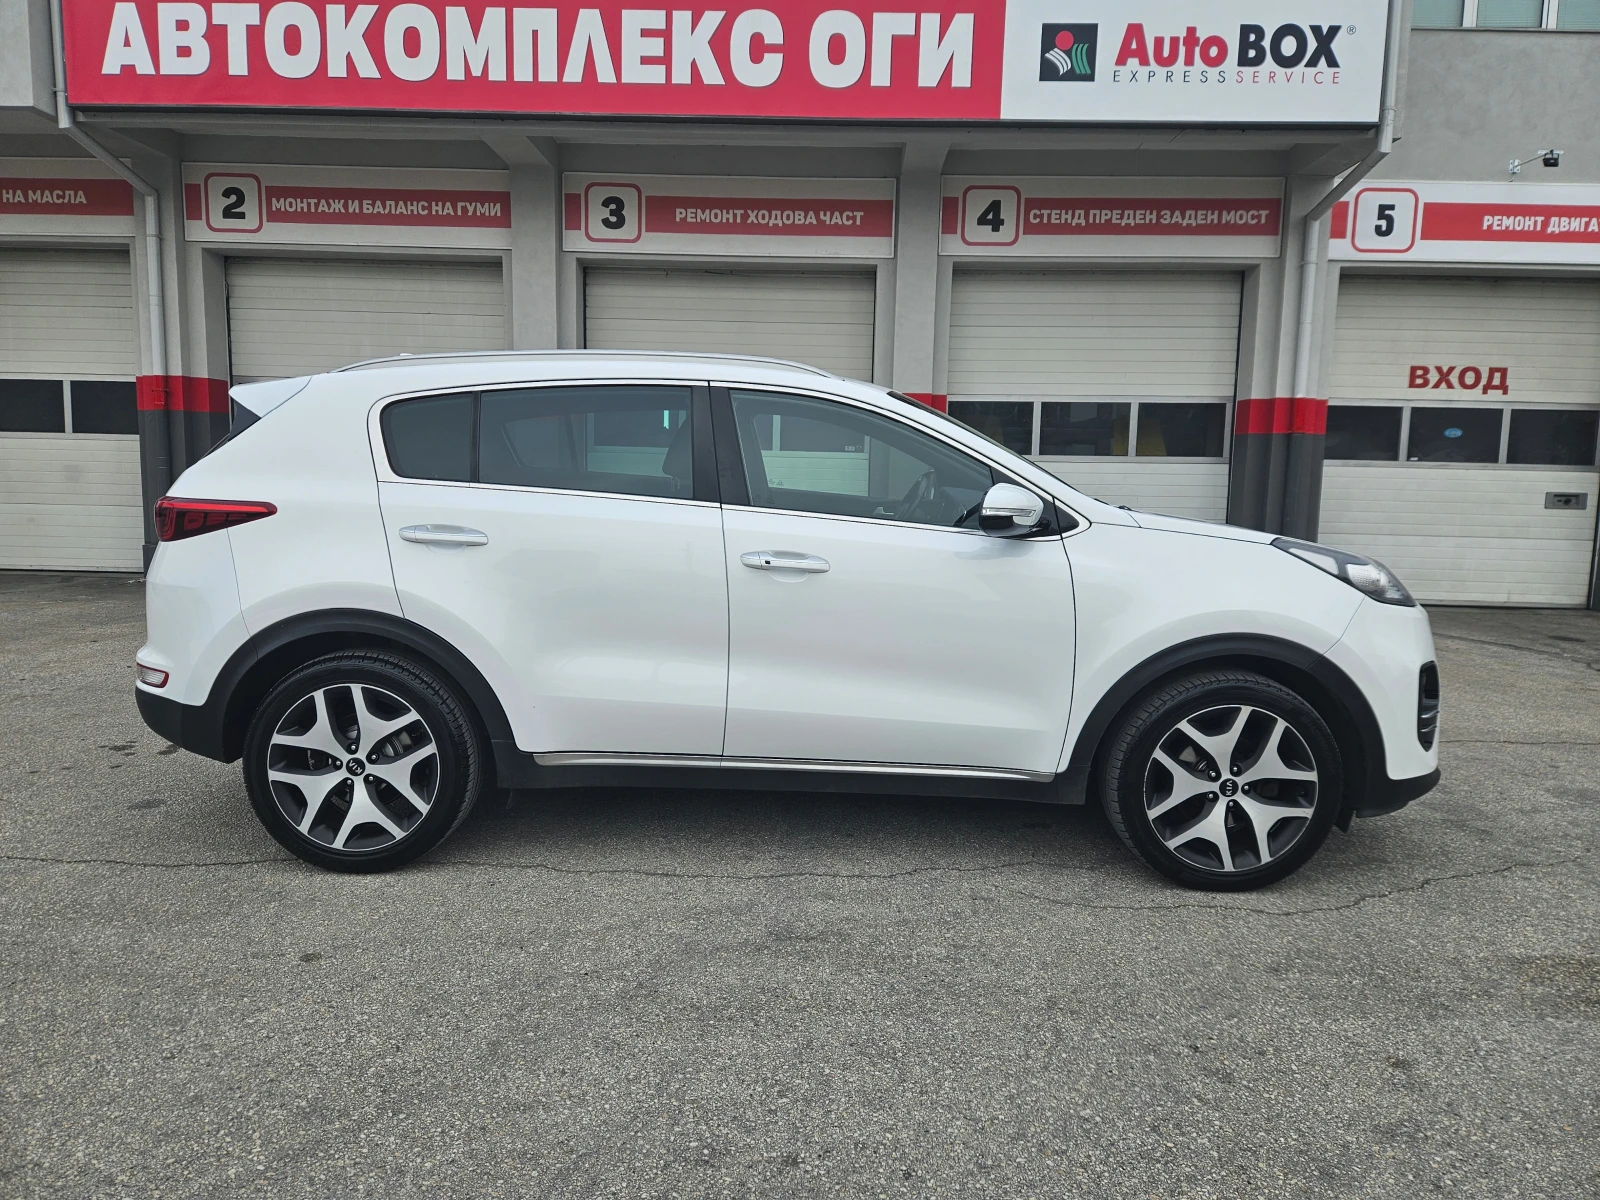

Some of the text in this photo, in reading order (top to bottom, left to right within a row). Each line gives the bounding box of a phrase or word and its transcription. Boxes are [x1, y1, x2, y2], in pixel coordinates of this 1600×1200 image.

[101, 1, 975, 88] АВТОКОМПЛЕКС ОГИ
[1115, 23, 1343, 69] Auto BOX
[2, 189, 87, 204] НА МАСЛА
[221, 186, 247, 220] 2
[271, 197, 502, 217] МОНТАЖ И БАЛАНС НА ГУМИ
[600, 196, 626, 230] 3
[675, 208, 864, 227] РЕМОНТ ХОДОВА ЧАСТ
[976, 199, 1005, 233] 4
[1029, 209, 1270, 227] СТЕНД ПРЕДЕН ЗАДЕН МОСТ
[1374, 203, 1396, 238] 5
[1483, 215, 1600, 234] РЕМОНТ ДВИГА
[1408, 365, 1510, 396] ВХОД
[1225, 780, 1233, 796] KIA
